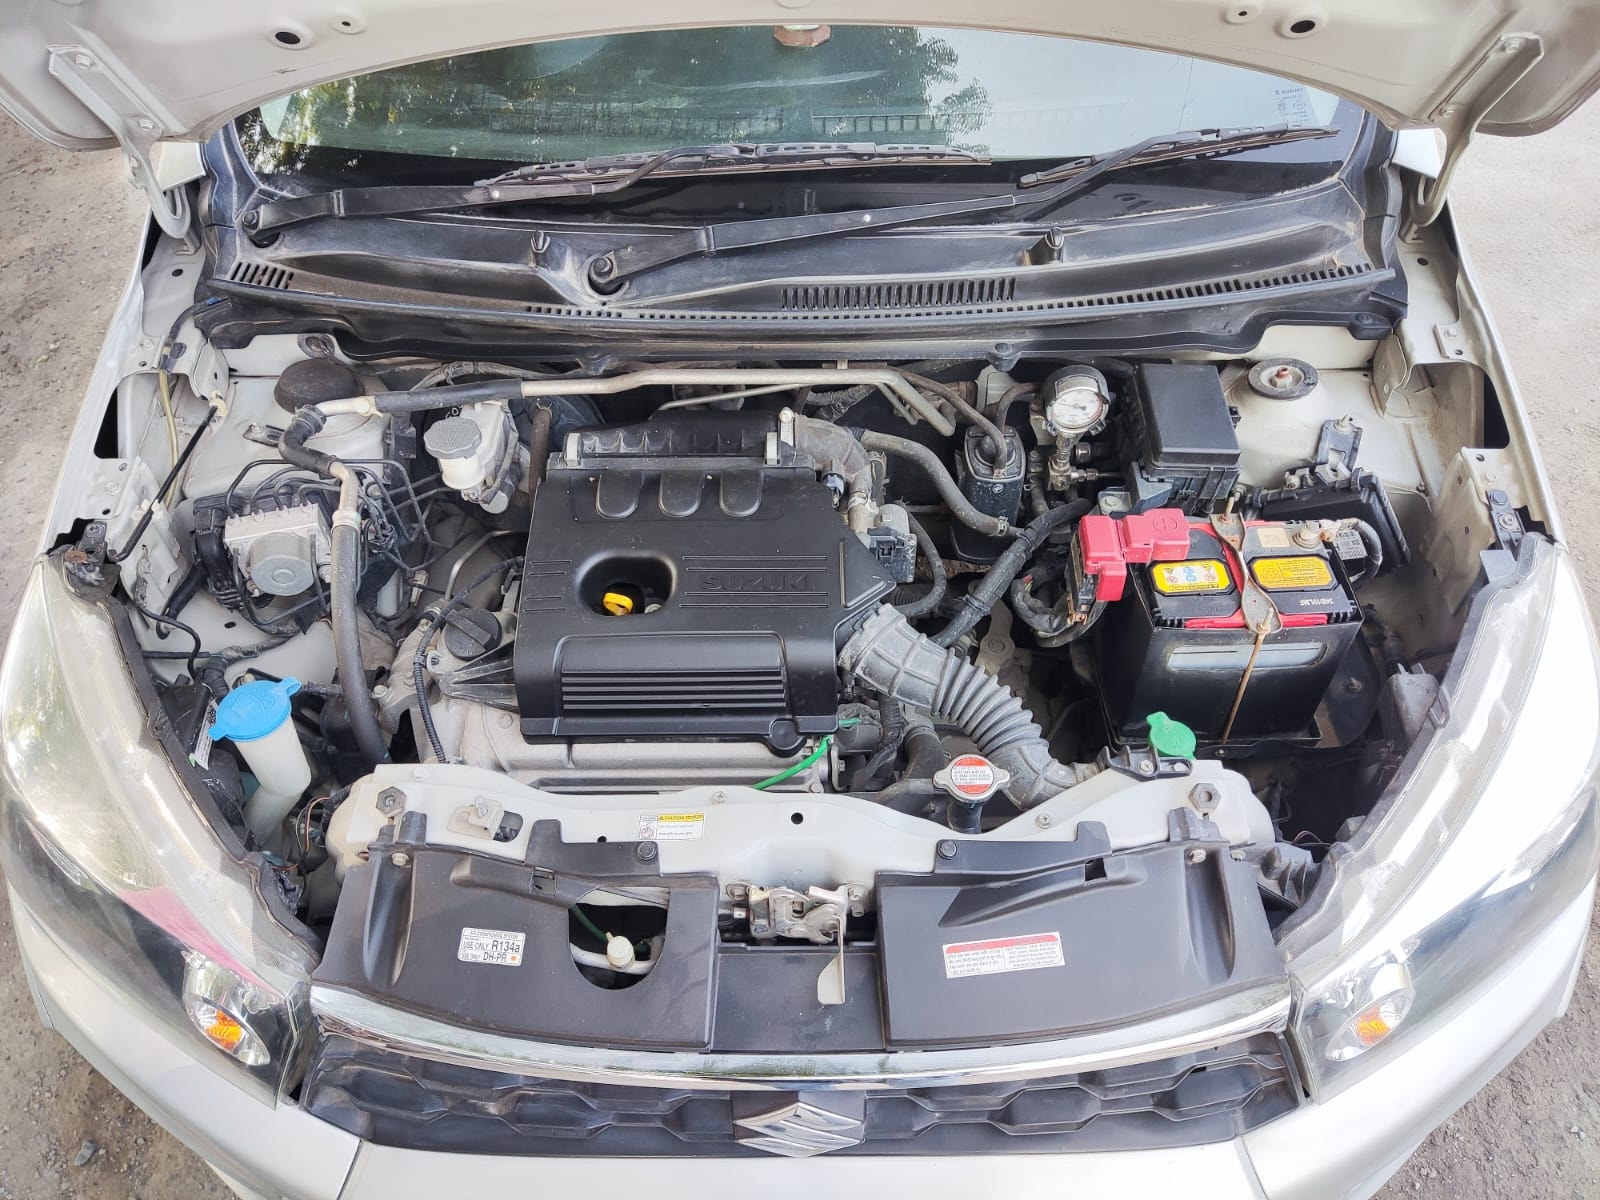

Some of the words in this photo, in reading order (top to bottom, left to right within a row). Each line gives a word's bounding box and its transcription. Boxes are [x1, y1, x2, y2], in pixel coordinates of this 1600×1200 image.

[703, 574, 817, 590] SUZUKI
[475, 942, 489, 951] ONLY
[491, 939, 521, 953] R134a
[483, 951, 507, 962] DH-PR
